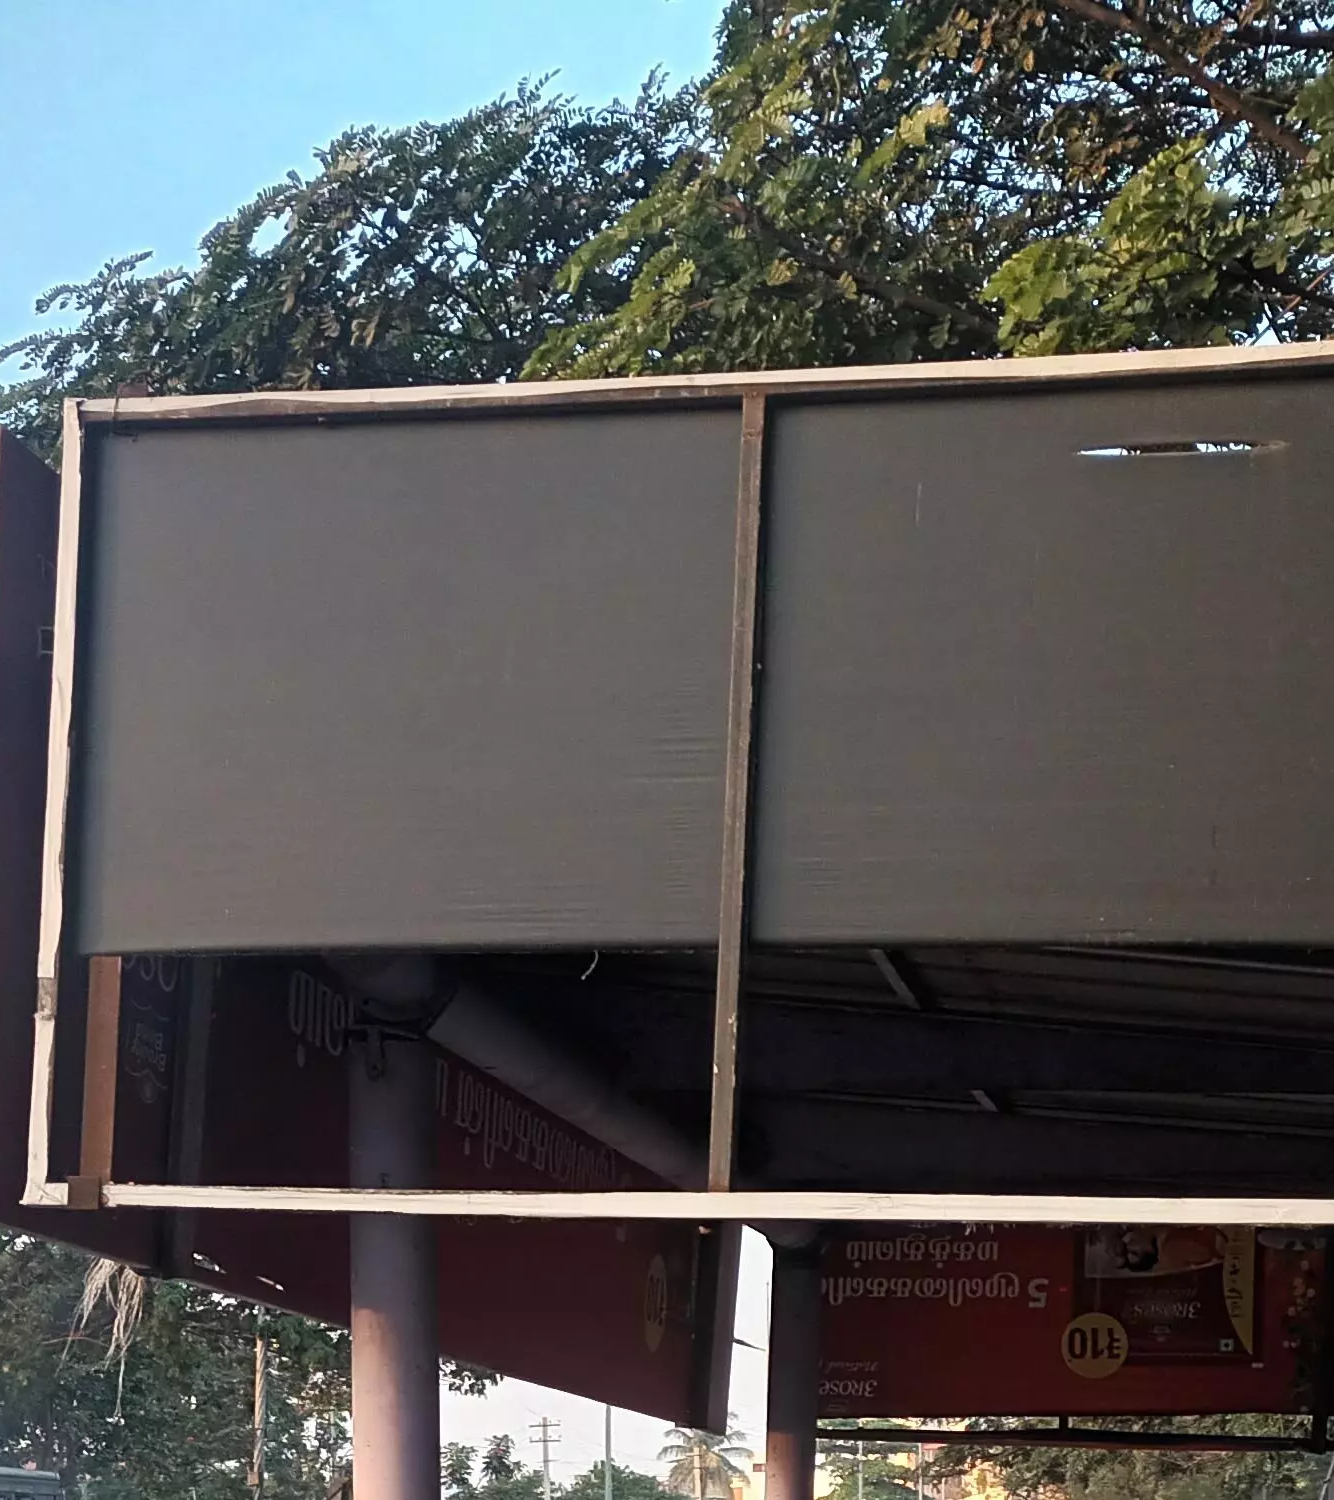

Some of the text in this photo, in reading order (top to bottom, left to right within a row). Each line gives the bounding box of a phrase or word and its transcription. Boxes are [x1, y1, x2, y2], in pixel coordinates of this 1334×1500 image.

[820, 1272, 1049, 1308] 5 மூலிகைகளி
[1067, 1327, 1122, 1363] ₹10
